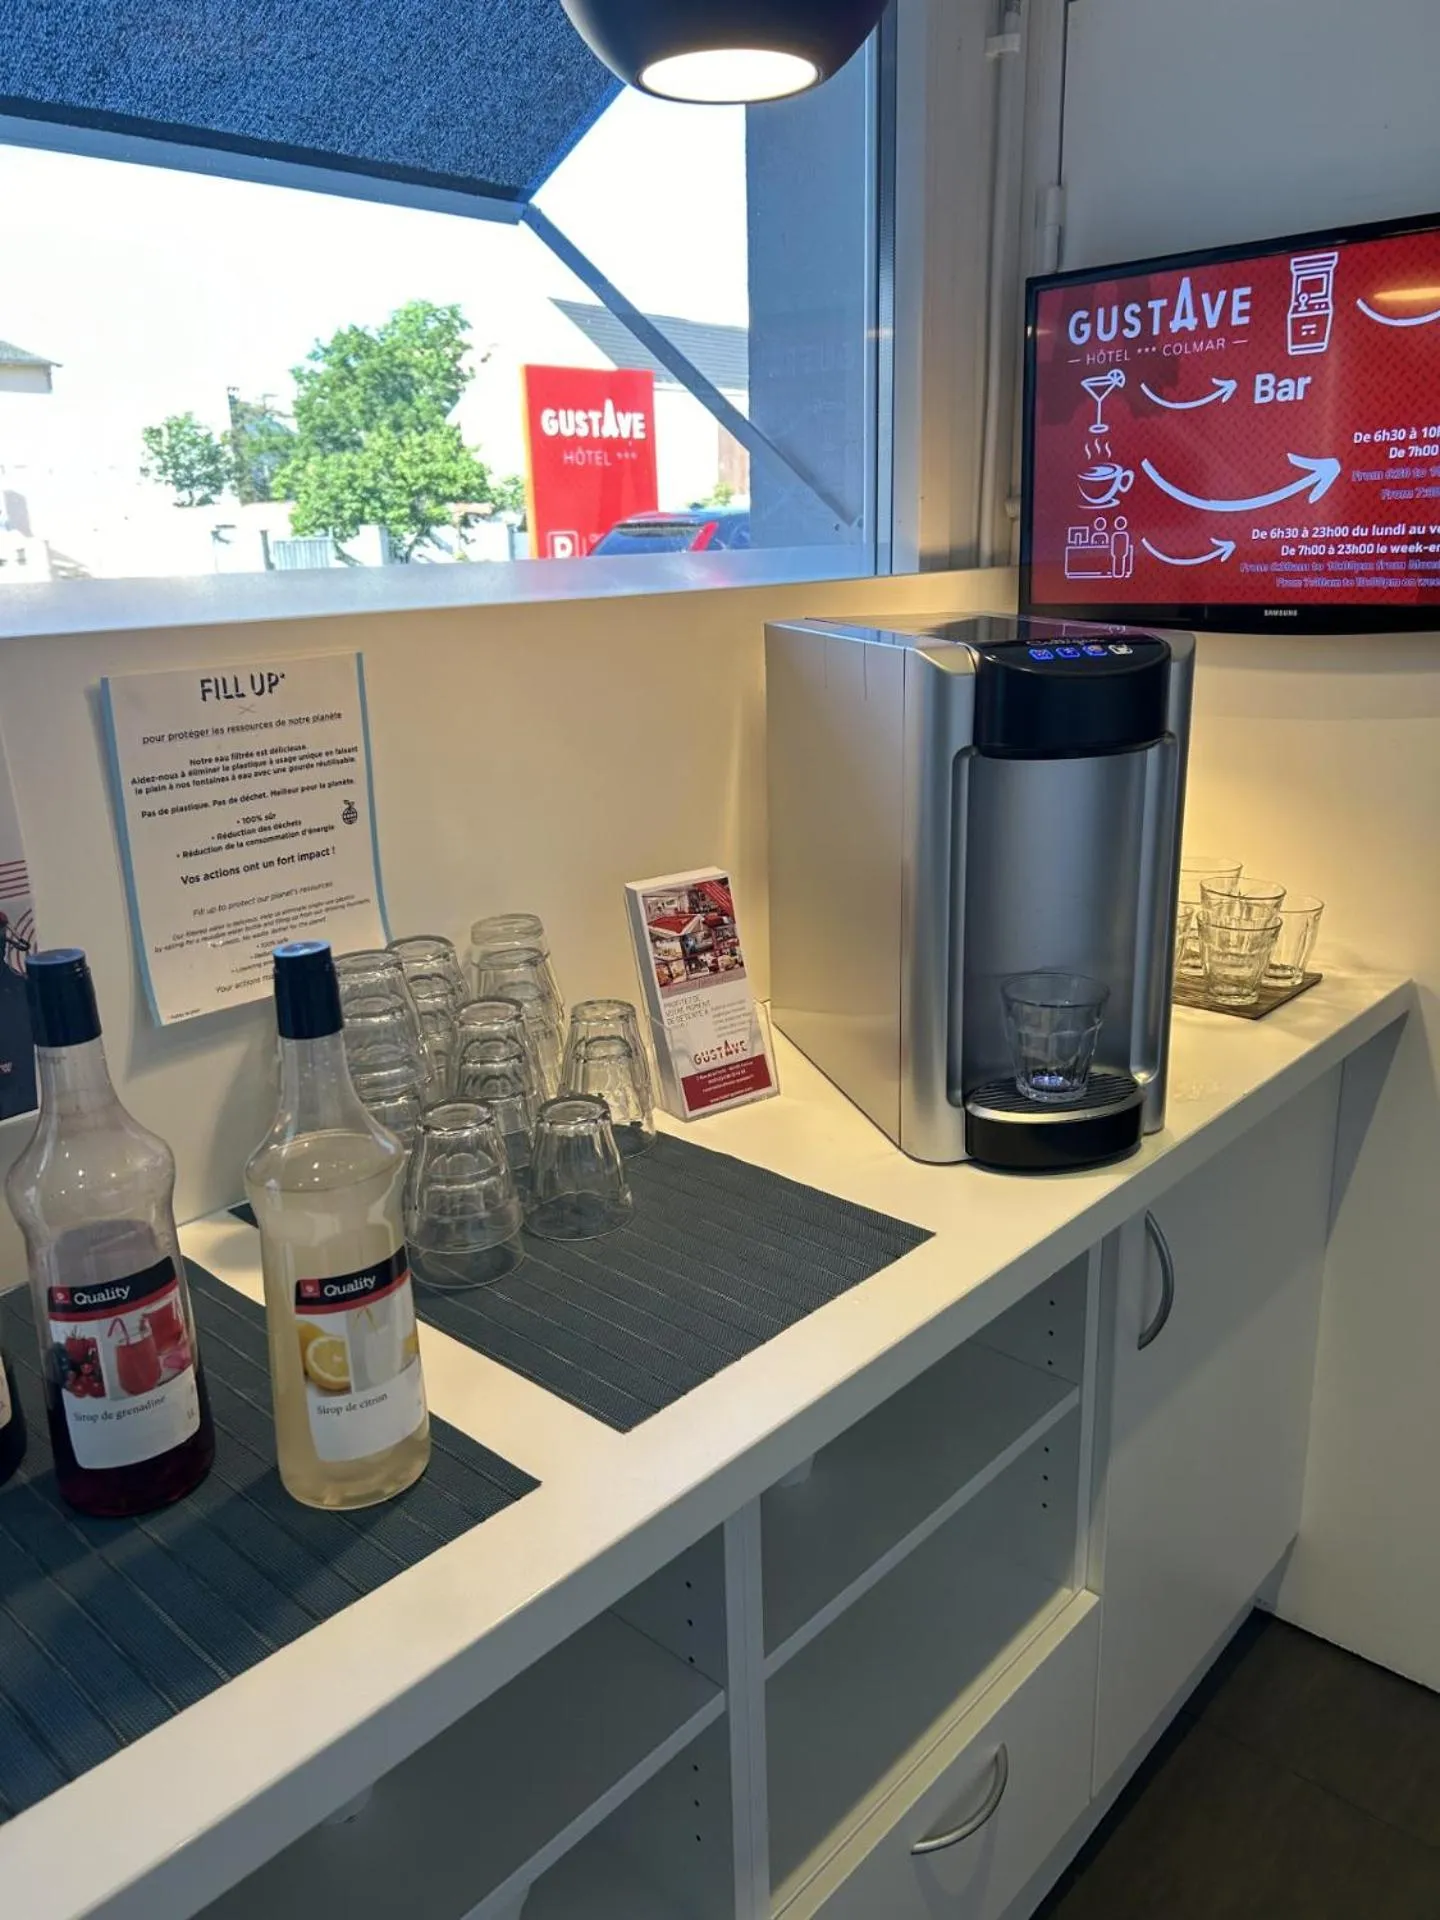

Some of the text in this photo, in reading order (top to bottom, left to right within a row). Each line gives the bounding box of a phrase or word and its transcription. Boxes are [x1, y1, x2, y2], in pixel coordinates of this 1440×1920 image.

[1068, 276, 1252, 346] GUSTAVE
[1086, 338, 1226, 365] HÔTEL COLMAR
[1254, 372, 1312, 404] Bar
[541, 398, 647, 440] GUSTAVE
[1353, 431, 1371, 444] De
[1374, 428, 1406, 442] 6h30
[1409, 426, 1417, 440] à
[563, 446, 612, 467] HÔTEL
[1389, 444, 1439, 459] De 7h00
[1251, 528, 1268, 540] De
[1270, 527, 1299, 539] 6h30
[1301, 527, 1309, 538] à
[1311, 525, 1349, 538] 23h00
[1352, 525, 1369, 537] du
[1372, 523, 1406, 536] lundi
[1409, 525, 1426, 535] au
[1281, 544, 1295, 556] De
[1298, 544, 1326, 556] 7h00
[1328, 544, 1335, 555] à
[1337, 543, 1374, 555] 23h00
[1376, 543, 1387, 554] le
[200, 675, 246, 702] FILL
[142, 711, 342, 746] pour protéger les ressources de notre planète
[189, 755, 213, 766] Notre
[214, 754, 230, 762] eau
[256, 748, 268, 757] est
[131, 772, 179, 785] Aidez-nous
[222, 763, 230, 771] le
[231, 760, 267, 772] plastique
[175, 780, 191, 789] nos
[254, 768, 272, 778] avec
[141, 809, 156, 819] Pas
[158, 807, 169, 816] de
[212, 798, 226, 807] Pas
[228, 796, 238, 805] de
[216, 827, 256, 840] Réduction
[258, 825, 272, 833] des
[182, 845, 223, 858] Réduction
[225, 842, 235, 850] de
[236, 840, 244, 848] la
[180, 874, 200, 885] Vos
[203, 866, 240, 881] actions
[243, 861, 260, 873] ont
[262, 860, 275, 869] un
[277, 855, 295, 866] fort
[297, 847, 330, 862] impact
[693, 1039, 748, 1065] GUSTAVE
[74, 1285, 130, 1305] Quality
[323, 1275, 376, 1297] Quality
[73, 1395, 166, 1423] Sirop de grenadine
[317, 1392, 388, 1416] Sirop de citron
